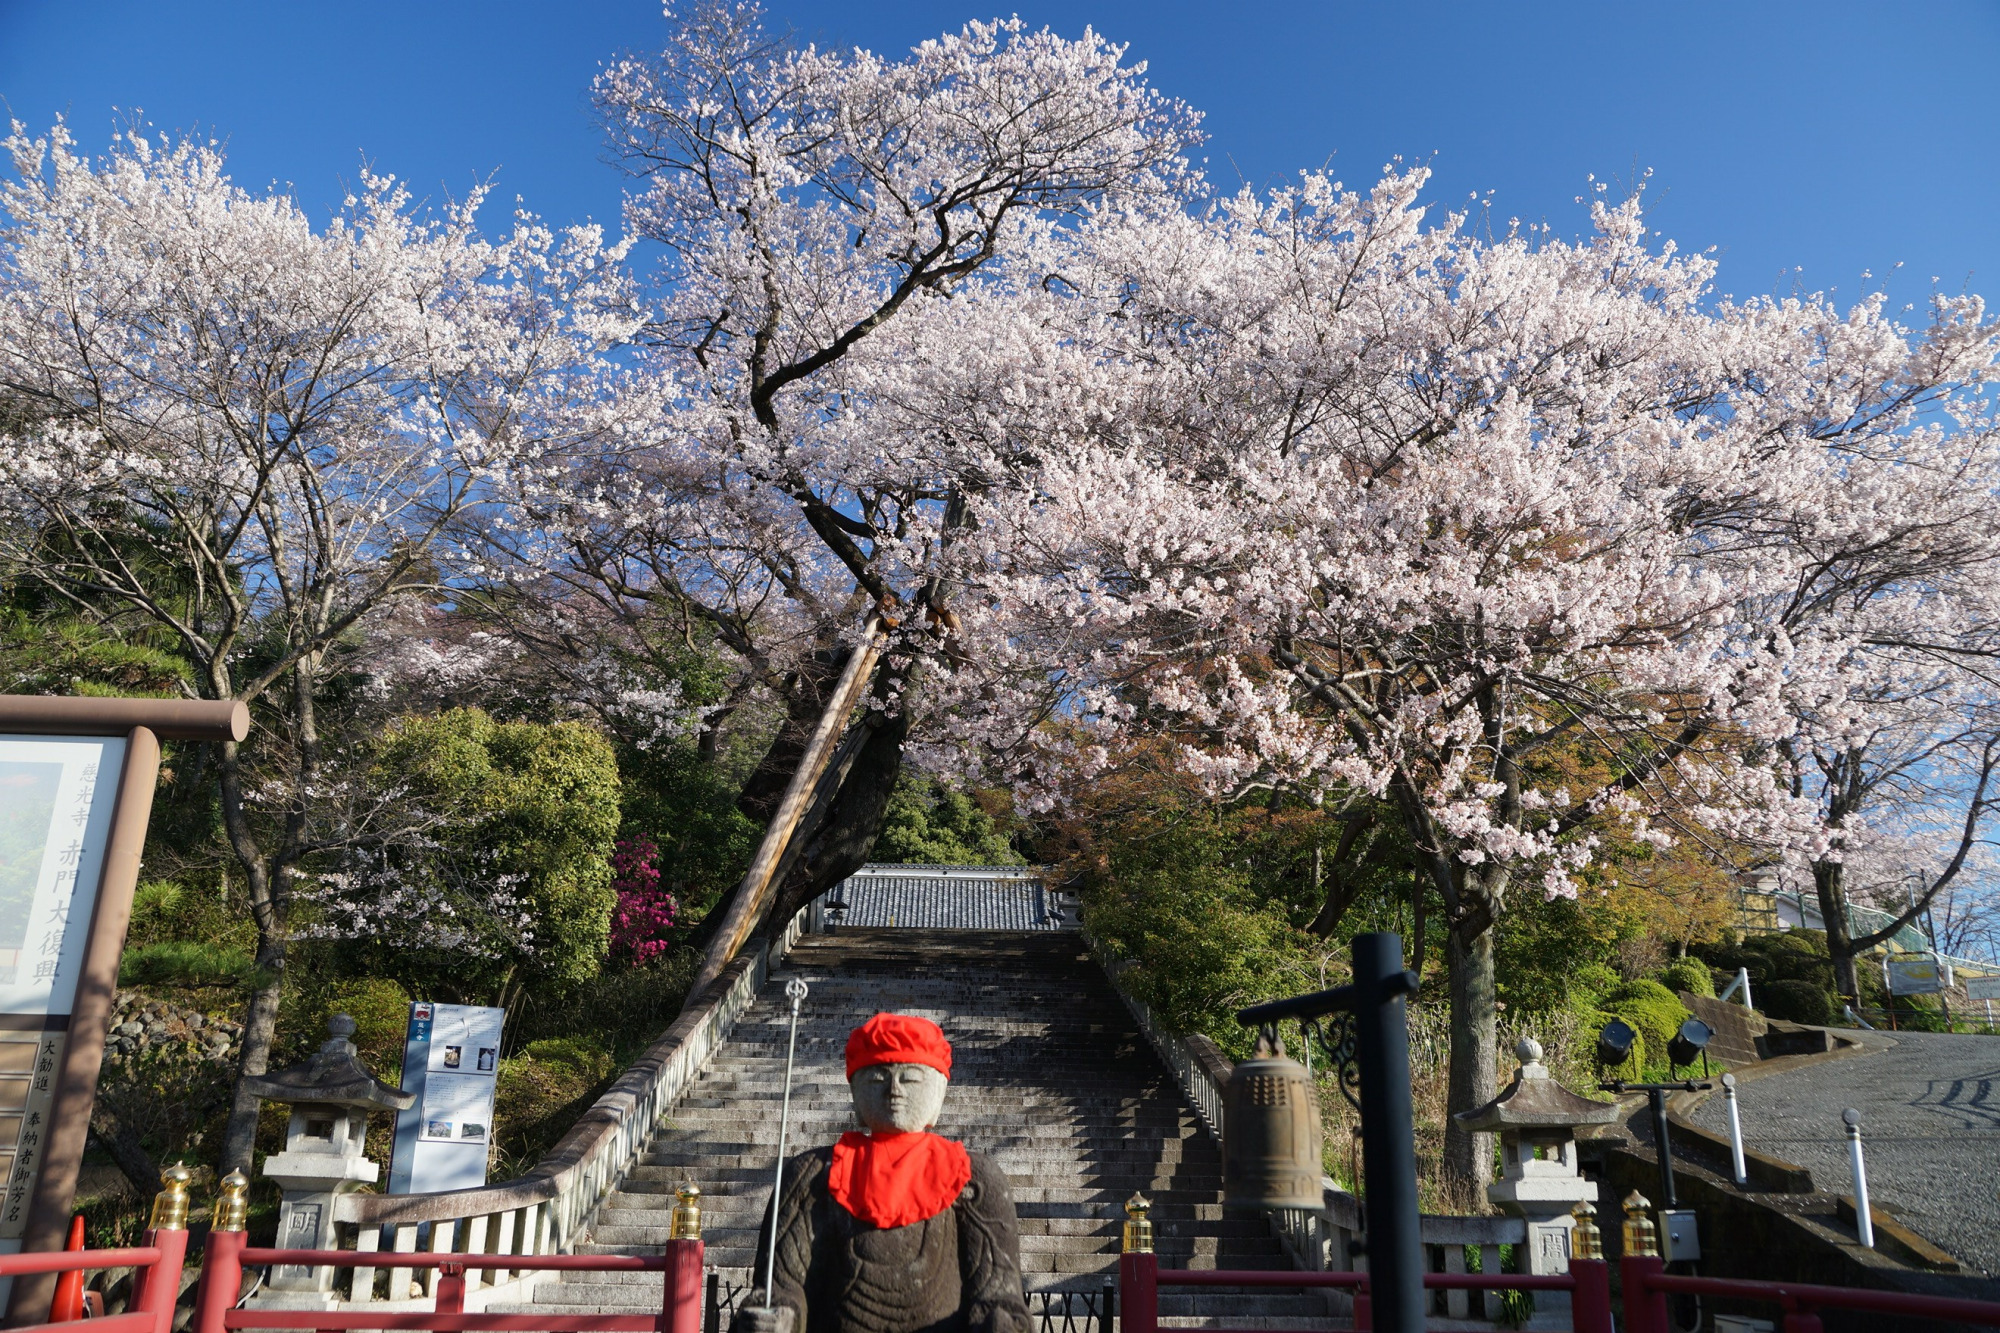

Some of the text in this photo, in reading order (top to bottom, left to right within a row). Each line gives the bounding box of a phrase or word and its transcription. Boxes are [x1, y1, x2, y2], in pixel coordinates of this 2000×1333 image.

[32, 763, 98, 986] 慈光寺 赤門大復興
[7, 1111, 40, 1222] 奉納者御芳名
